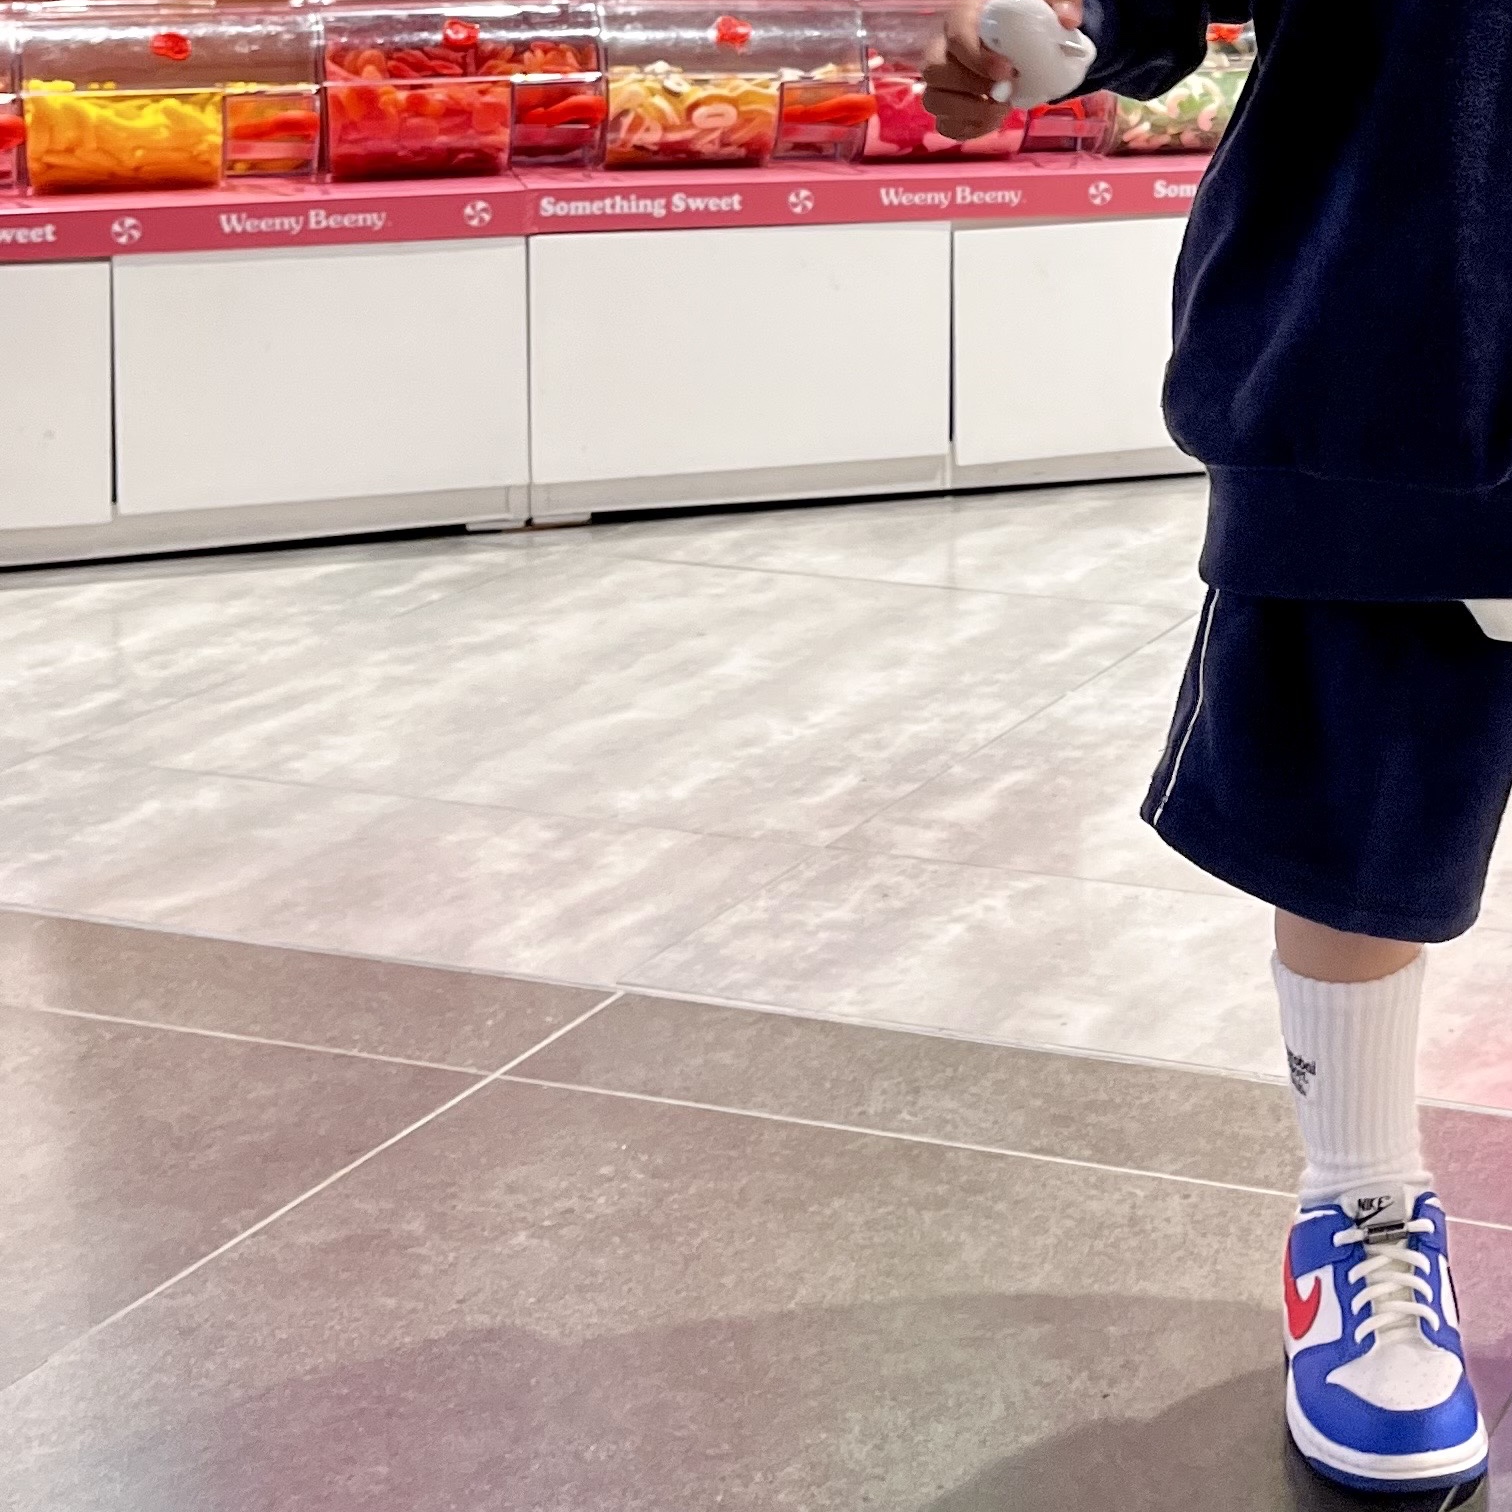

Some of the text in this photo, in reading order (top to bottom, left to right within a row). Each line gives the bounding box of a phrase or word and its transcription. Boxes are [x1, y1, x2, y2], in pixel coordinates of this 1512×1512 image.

[539, 190, 742, 219] Something Sweet
[880, 186, 952, 210] Weeny
[0, 223, 57, 245] weet
[219, 211, 305, 236] Weeny
[1357, 1195, 1392, 1211] NIKE
